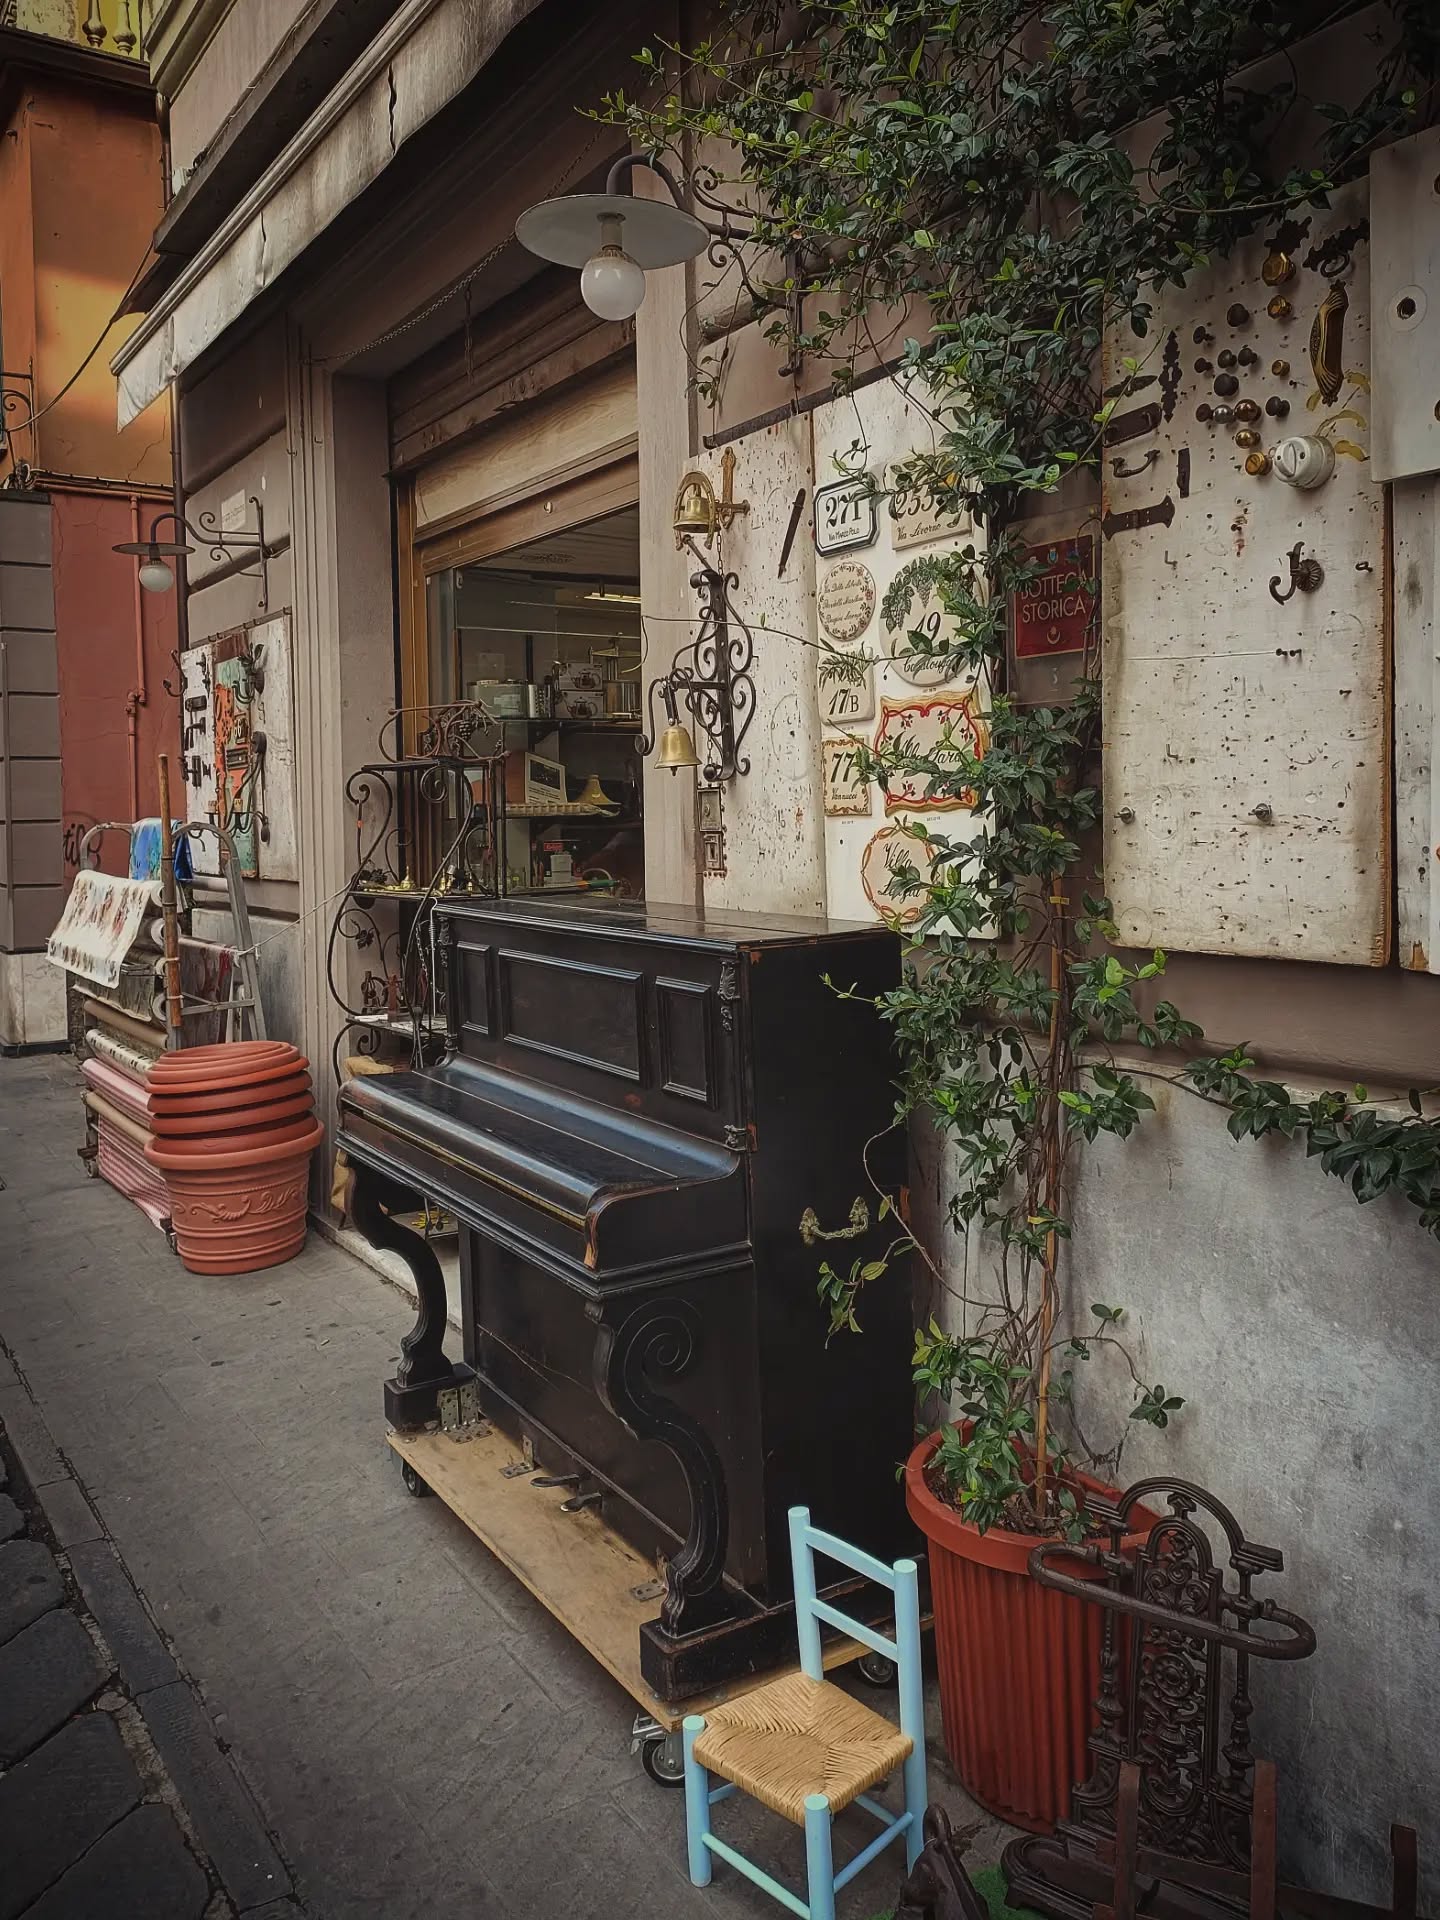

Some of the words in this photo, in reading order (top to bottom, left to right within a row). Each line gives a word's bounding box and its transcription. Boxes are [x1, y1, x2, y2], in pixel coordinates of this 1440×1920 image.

[825, 491, 862, 529] 271
[897, 526, 907, 541] Via
[910, 522, 942, 538] Livorno
[1022, 595, 1086, 623] STORICA
[829, 688, 859, 715] 17/B
[831, 752, 856, 783] 77
[832, 787, 857, 800] Vannucci
[883, 842, 912, 868] Villa
